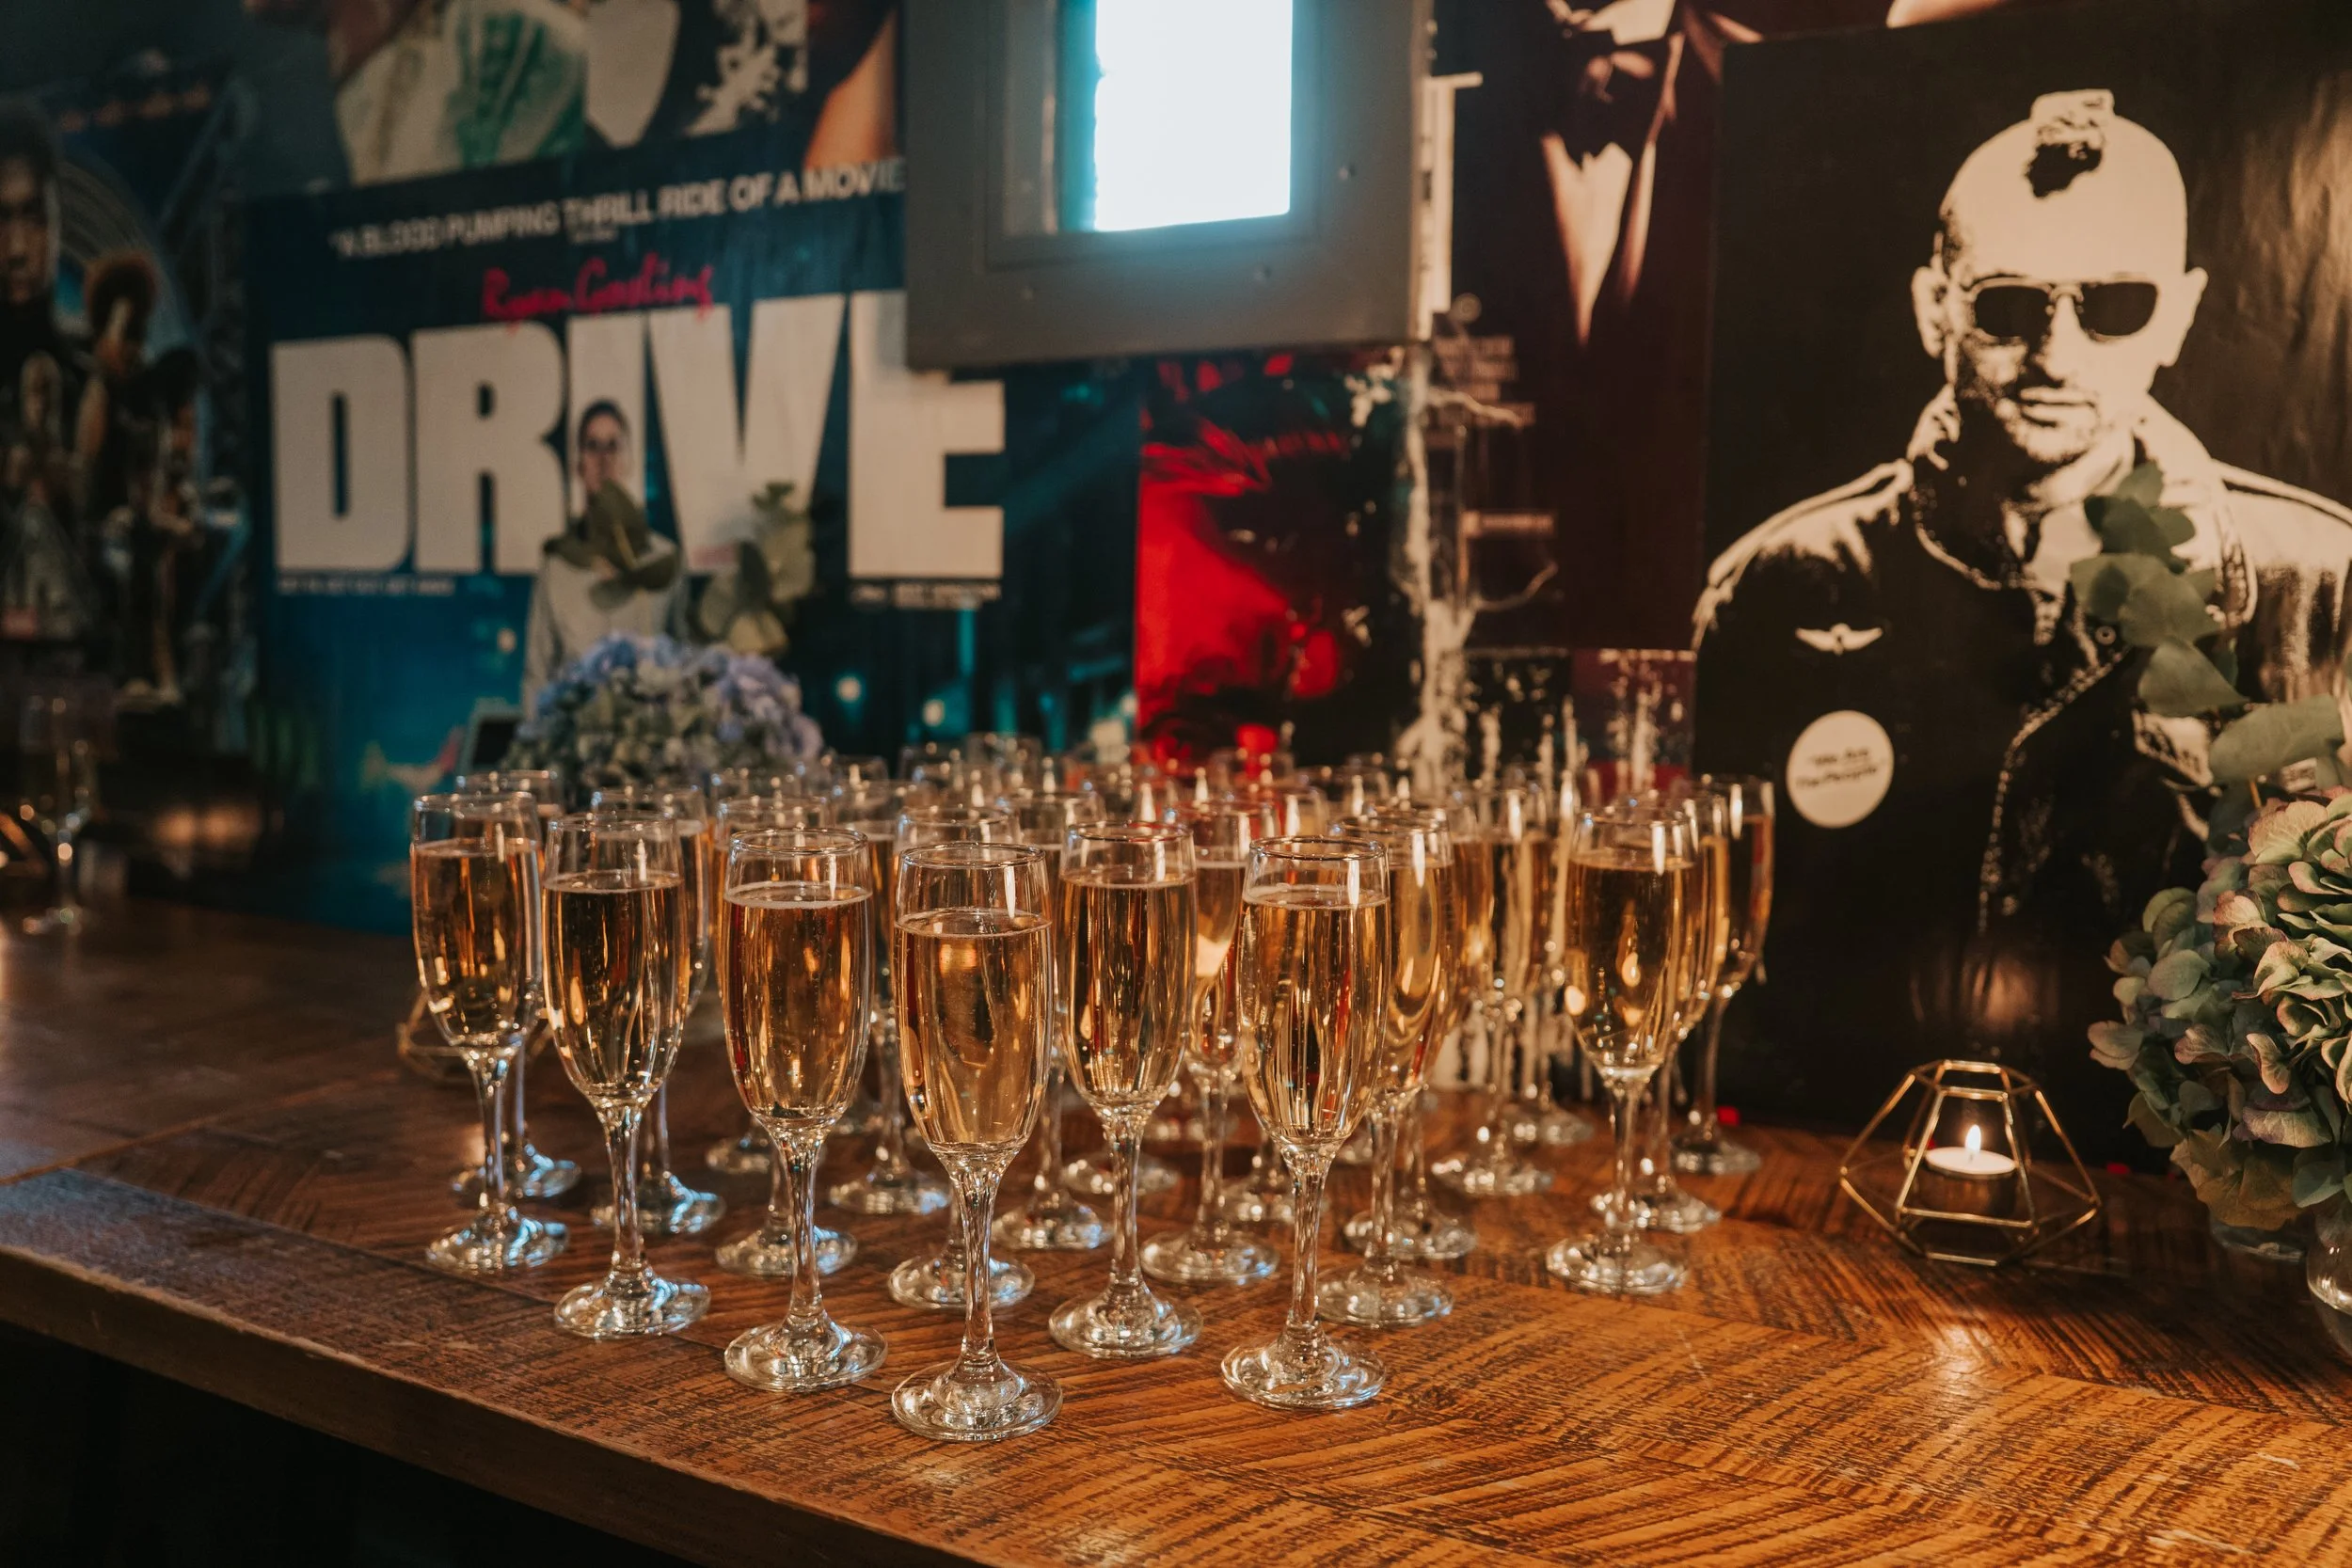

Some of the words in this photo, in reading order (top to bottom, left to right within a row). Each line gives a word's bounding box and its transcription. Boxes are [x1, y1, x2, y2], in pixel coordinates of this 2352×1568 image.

[446, 204, 563, 246] PUMPING
[564, 191, 654, 228] THRILL
[659, 179, 726, 219] RIDE
[730, 172, 774, 213] OF
[775, 169, 799, 207] A
[803, 157, 907, 201] MOVIE
[271, 291, 1005, 579] DRIVE
